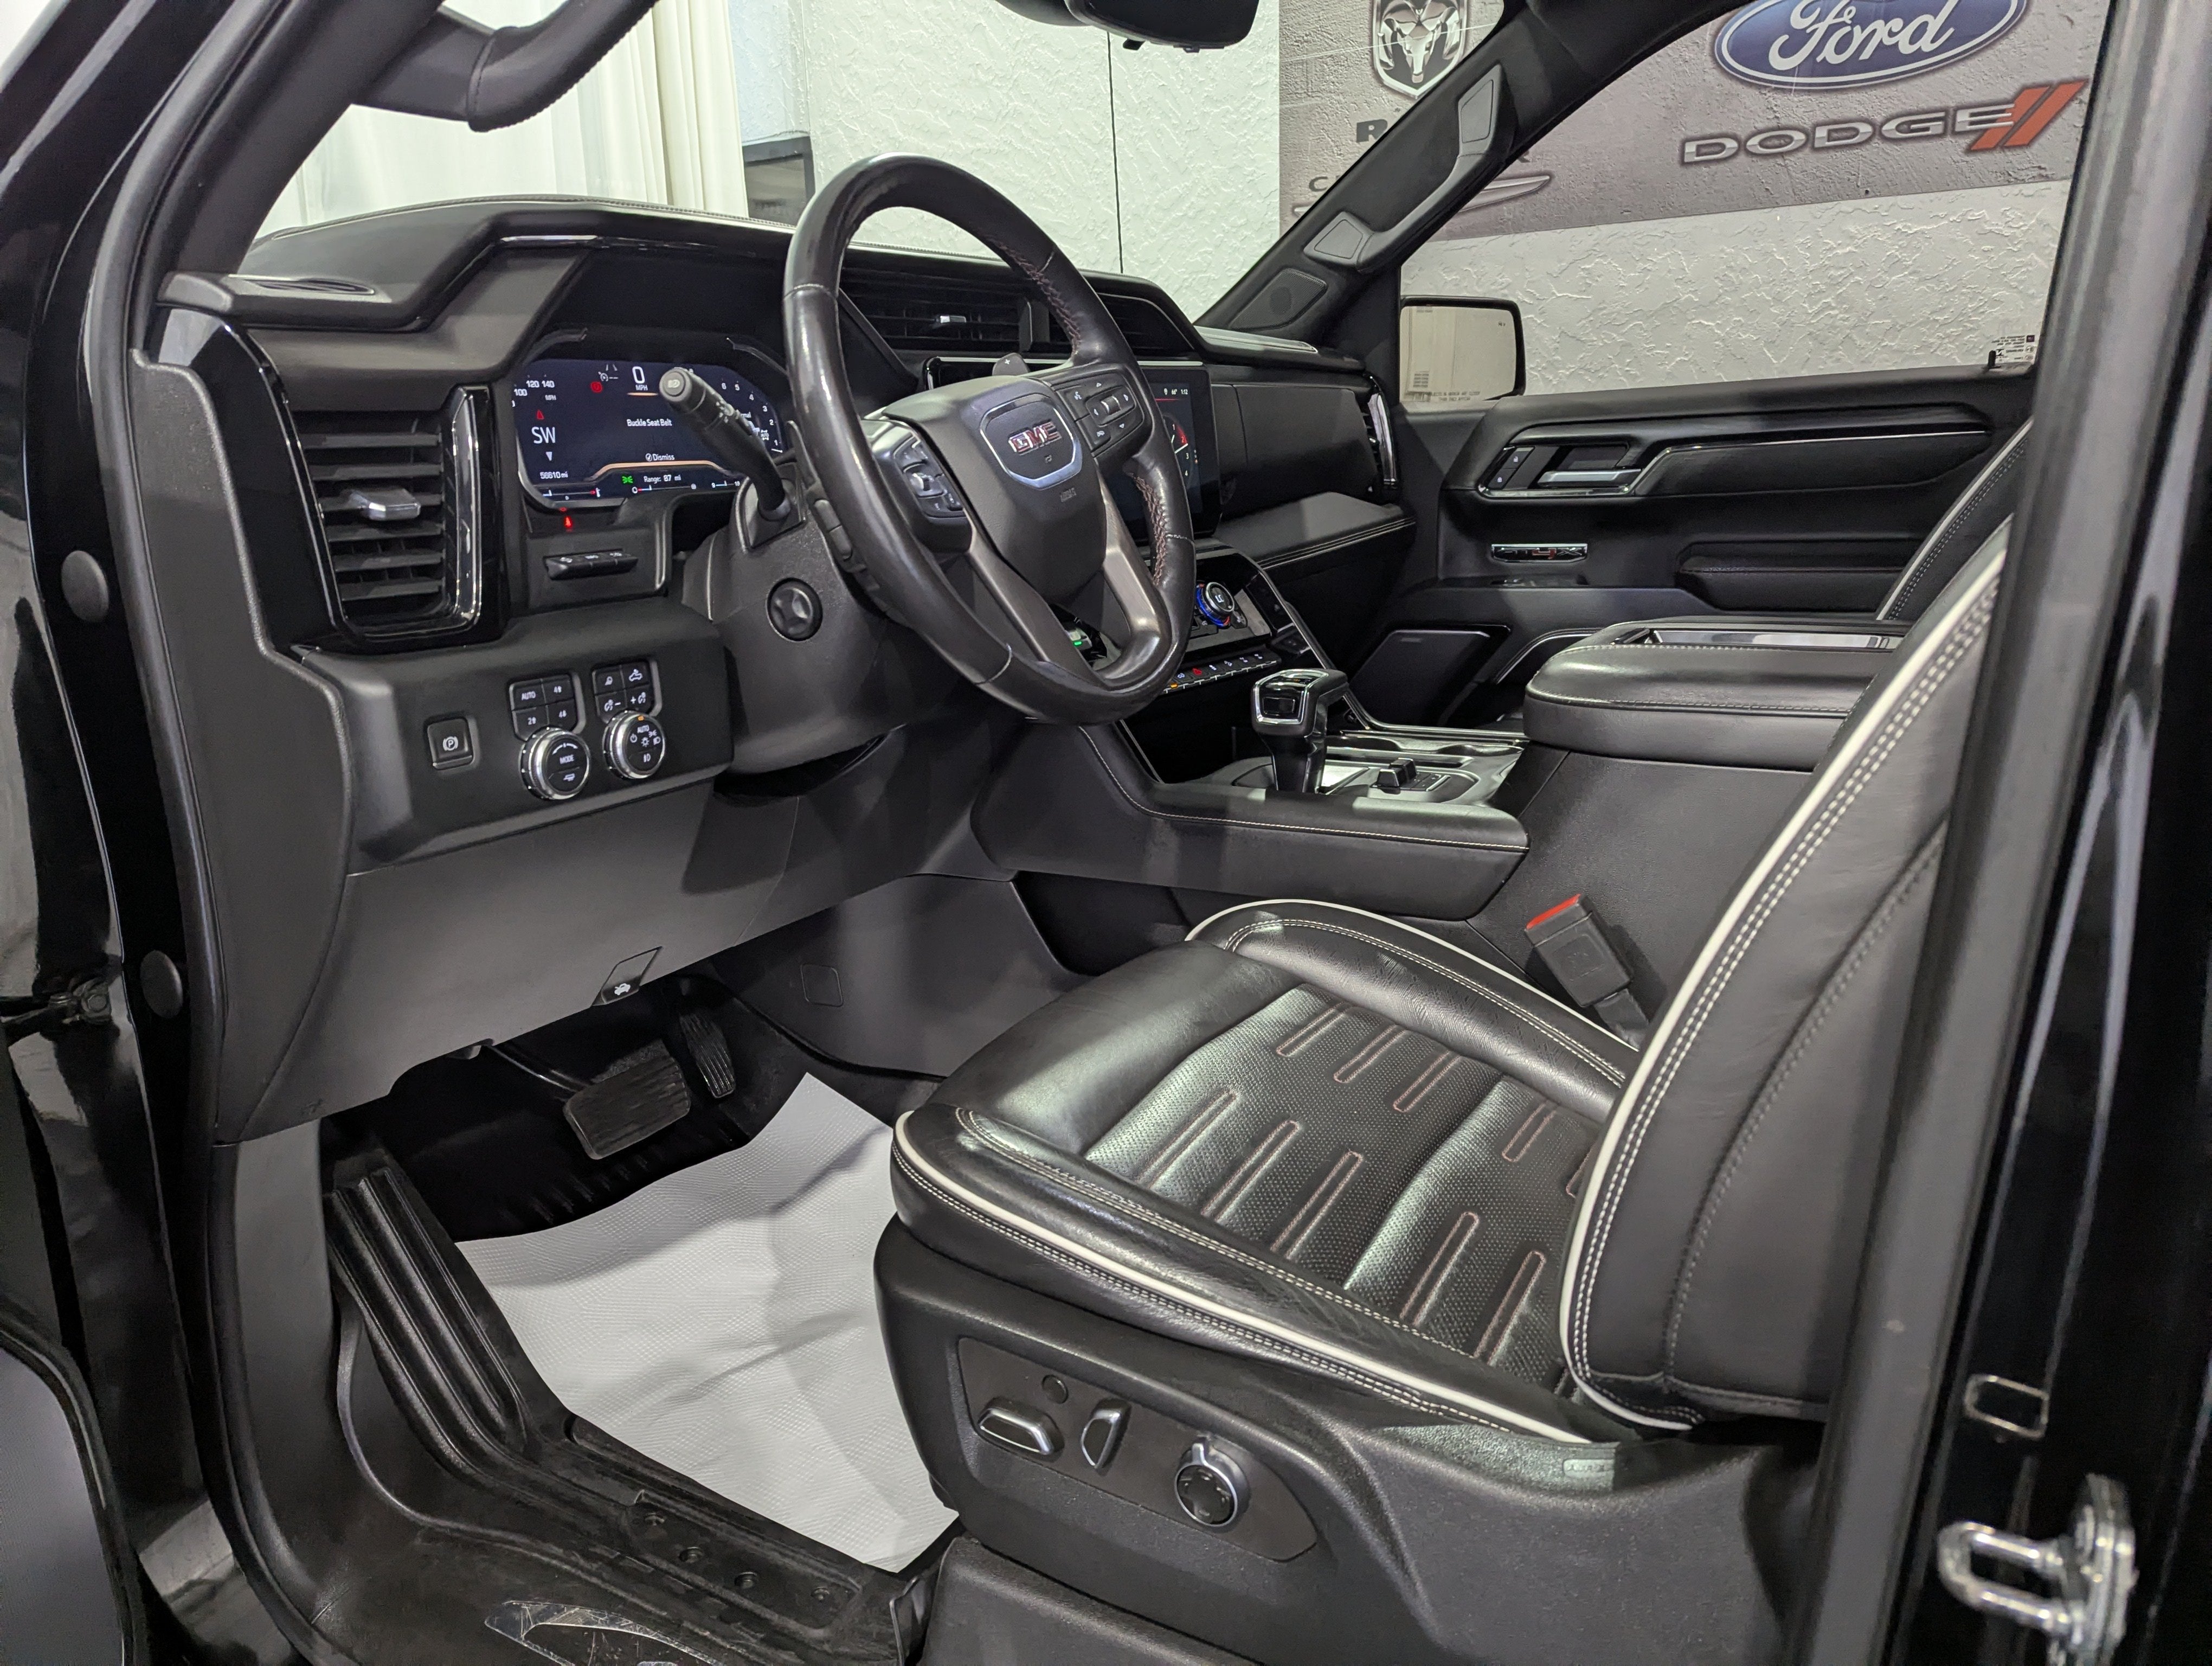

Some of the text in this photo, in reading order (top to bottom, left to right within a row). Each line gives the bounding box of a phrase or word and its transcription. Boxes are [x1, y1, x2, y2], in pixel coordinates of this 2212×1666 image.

[1768, 0, 1954, 71] Ford
[1684, 104, 2015, 163] DODGE
[632, 366, 645, 384] 0
[514, 388, 528, 396] 100
[646, 418, 660, 426] Seat
[660, 418, 672, 426] Belt
[531, 426, 556, 444] SW
[1008, 421, 1062, 456] GMC
[521, 690, 536, 701] AUTO
[560, 754, 575, 765] MODE
